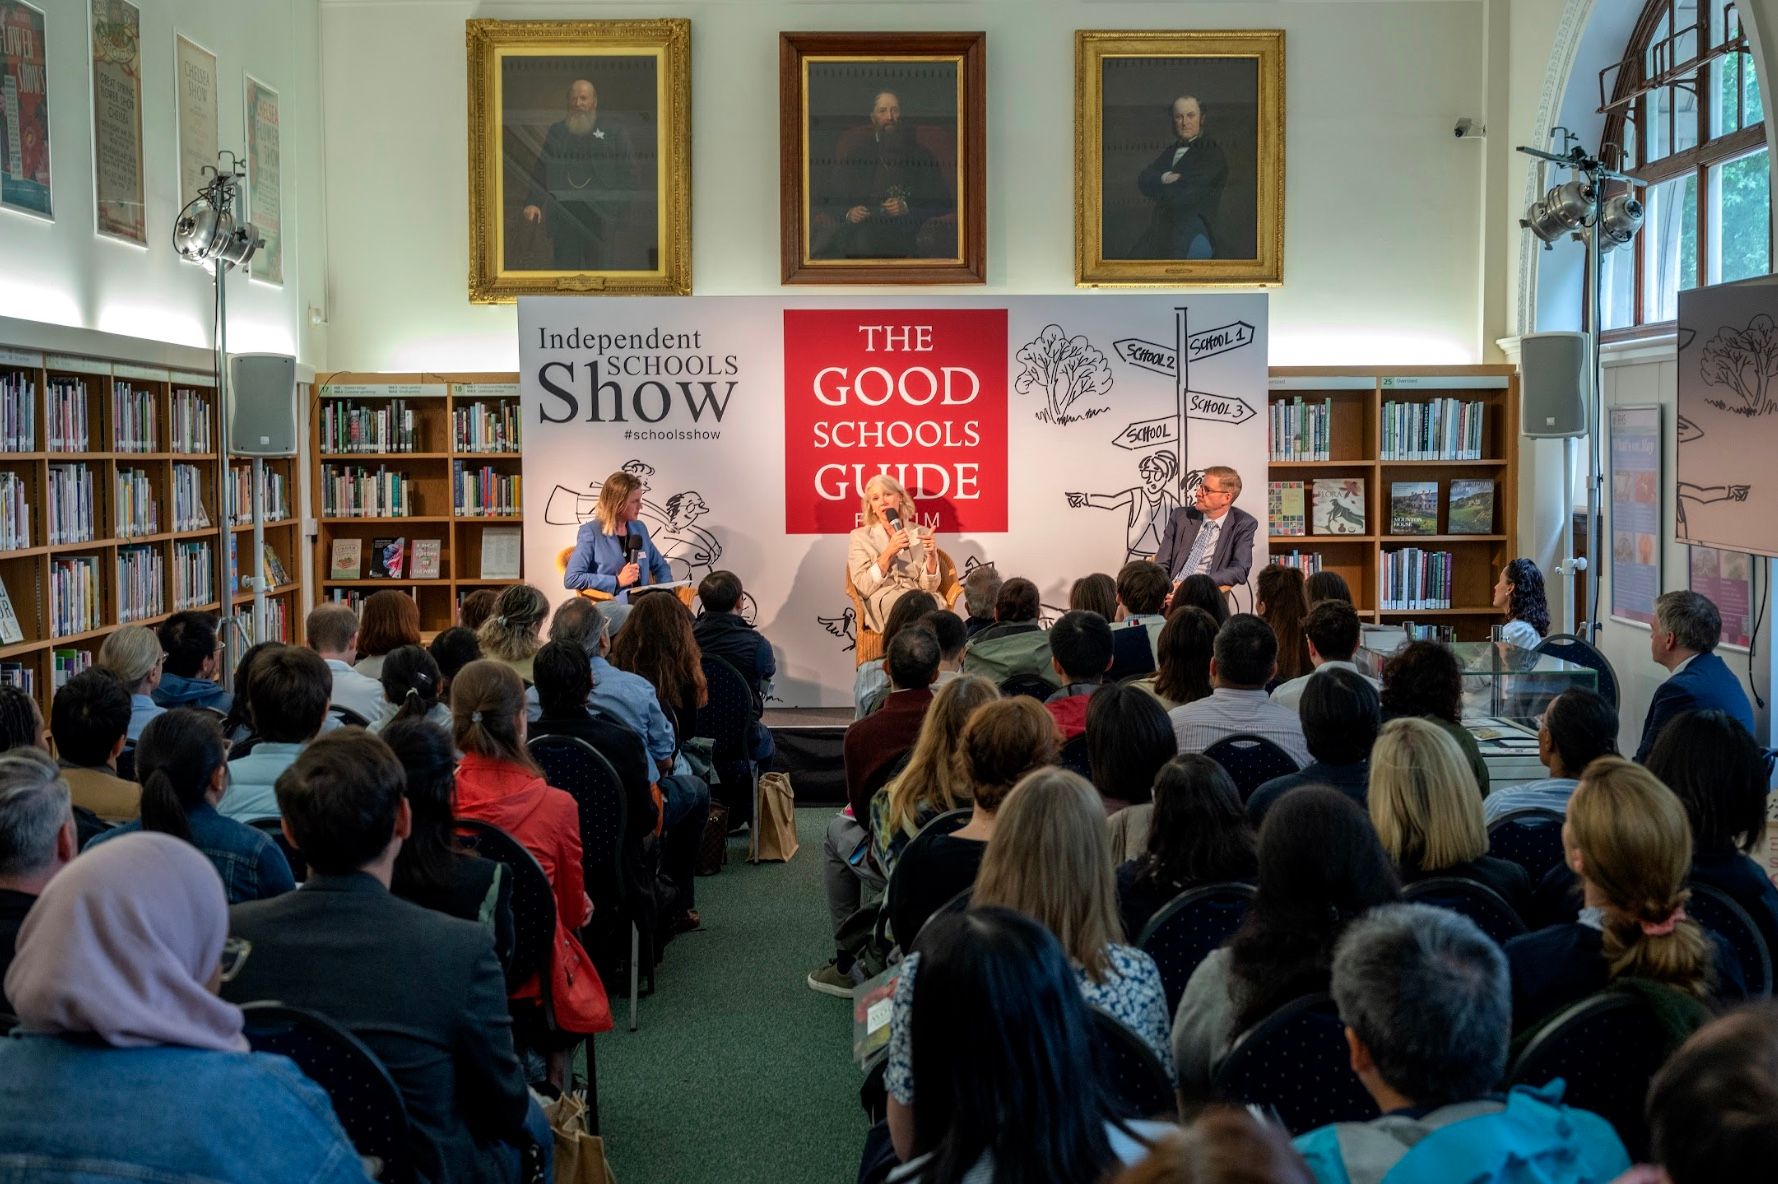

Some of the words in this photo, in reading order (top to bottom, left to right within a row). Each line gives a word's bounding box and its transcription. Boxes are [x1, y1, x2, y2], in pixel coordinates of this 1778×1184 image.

[184, 61, 209, 87] CHELSEA
[188, 80, 208, 102] SHOW
[538, 327, 702, 356] Independent
[858, 325, 934, 352] THE
[1189, 331, 1234, 355] SCHOOL
[1236, 327, 1246, 341] 1
[607, 355, 739, 376] SCHOOLS
[1127, 343, 1166, 368] SCHOOL
[1166, 356, 1175, 370] 2
[538, 360, 739, 424] Show
[813, 366, 980, 406] GOOD
[1383, 378, 1393, 386] 25
[1190, 395, 1231, 416] SCHOOL
[1232, 404, 1244, 419] 3
[624, 429, 721, 440] #schoolsshow
[813, 420, 980, 449] SCHOOLS
[1126, 424, 1171, 443] SCHOOL
